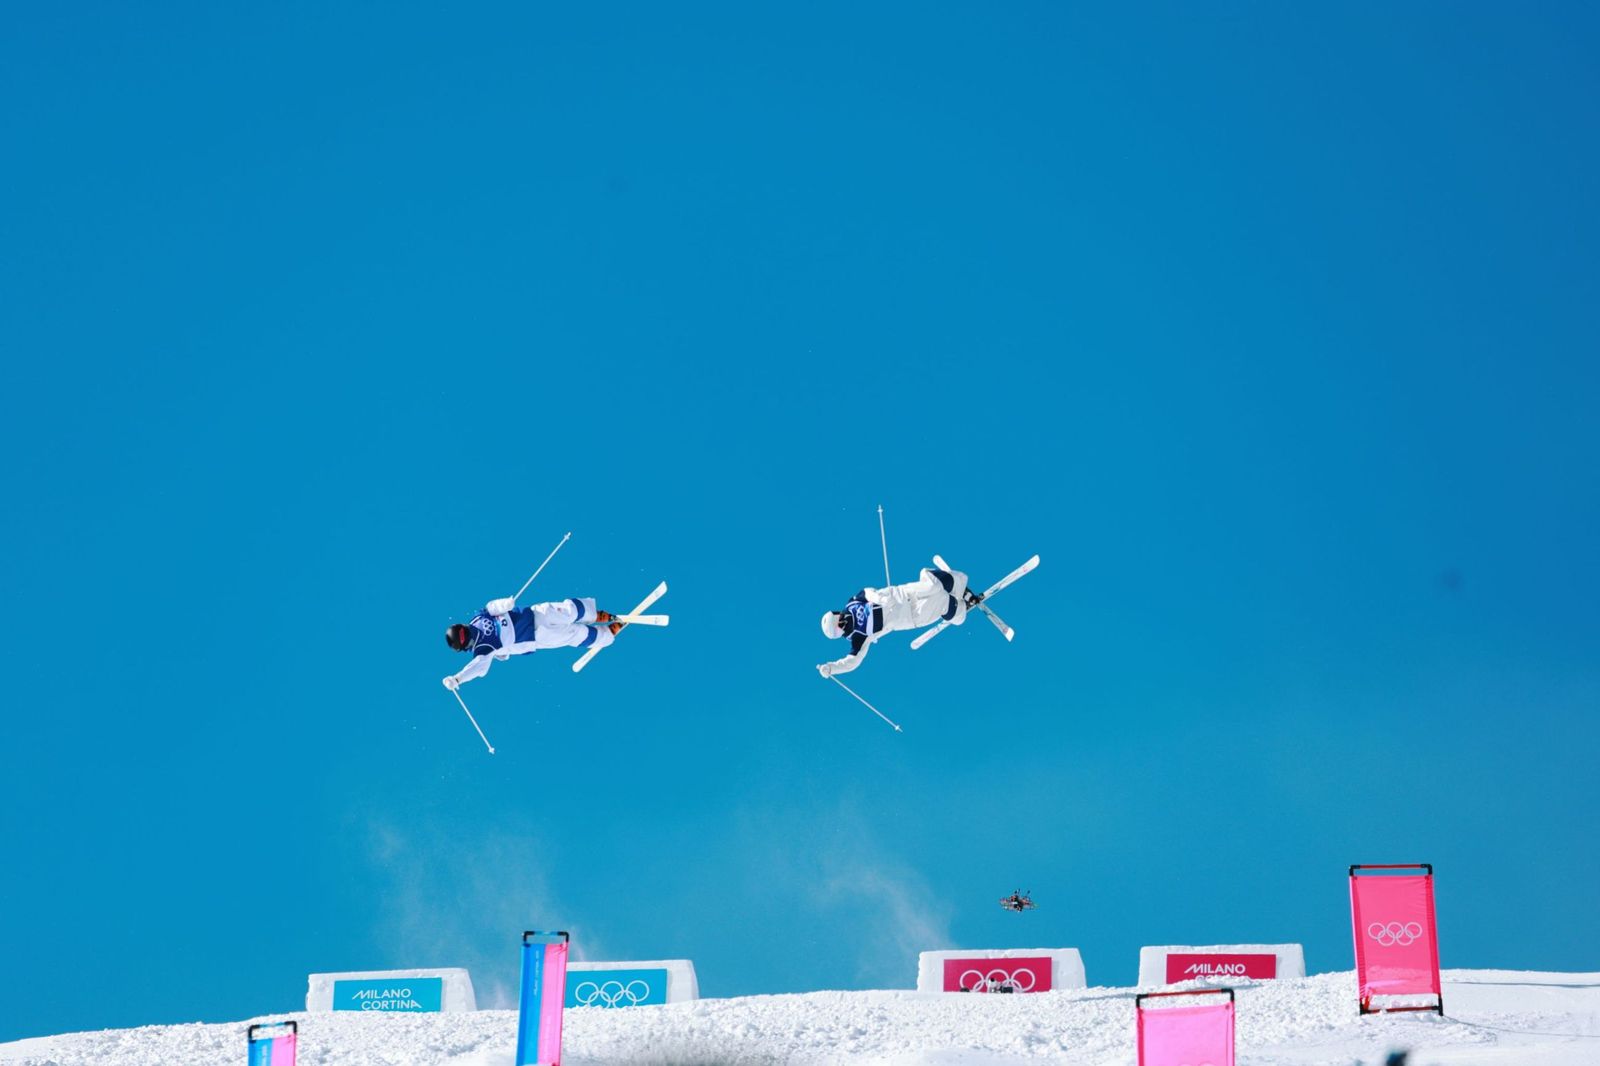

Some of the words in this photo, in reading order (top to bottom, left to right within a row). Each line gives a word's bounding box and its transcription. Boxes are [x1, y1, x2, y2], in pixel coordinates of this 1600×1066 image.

[1184, 963, 1246, 974] MILANO
[352, 988, 412, 1000] MILANO
[361, 1000, 422, 1010] CORTINA
